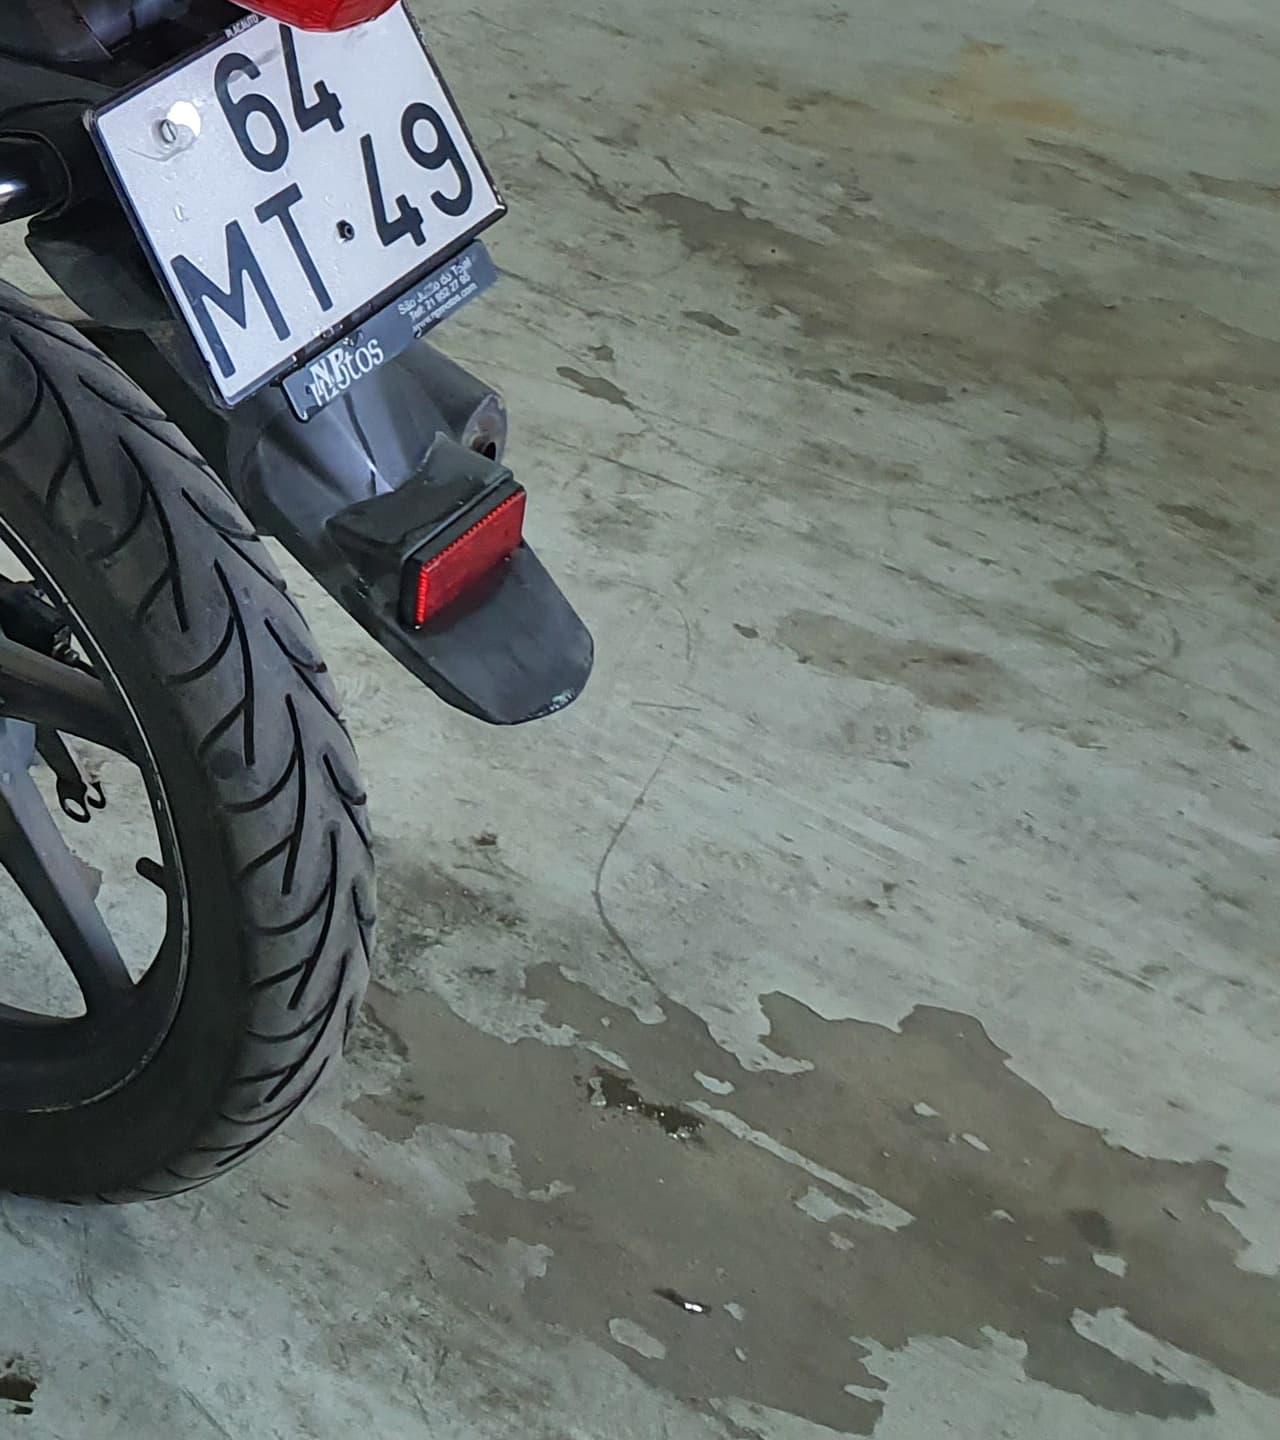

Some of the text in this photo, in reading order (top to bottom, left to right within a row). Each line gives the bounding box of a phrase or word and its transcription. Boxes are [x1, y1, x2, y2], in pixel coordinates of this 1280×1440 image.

[213, 24, 345, 173] 64
[171, 102, 473, 379] MT 49
